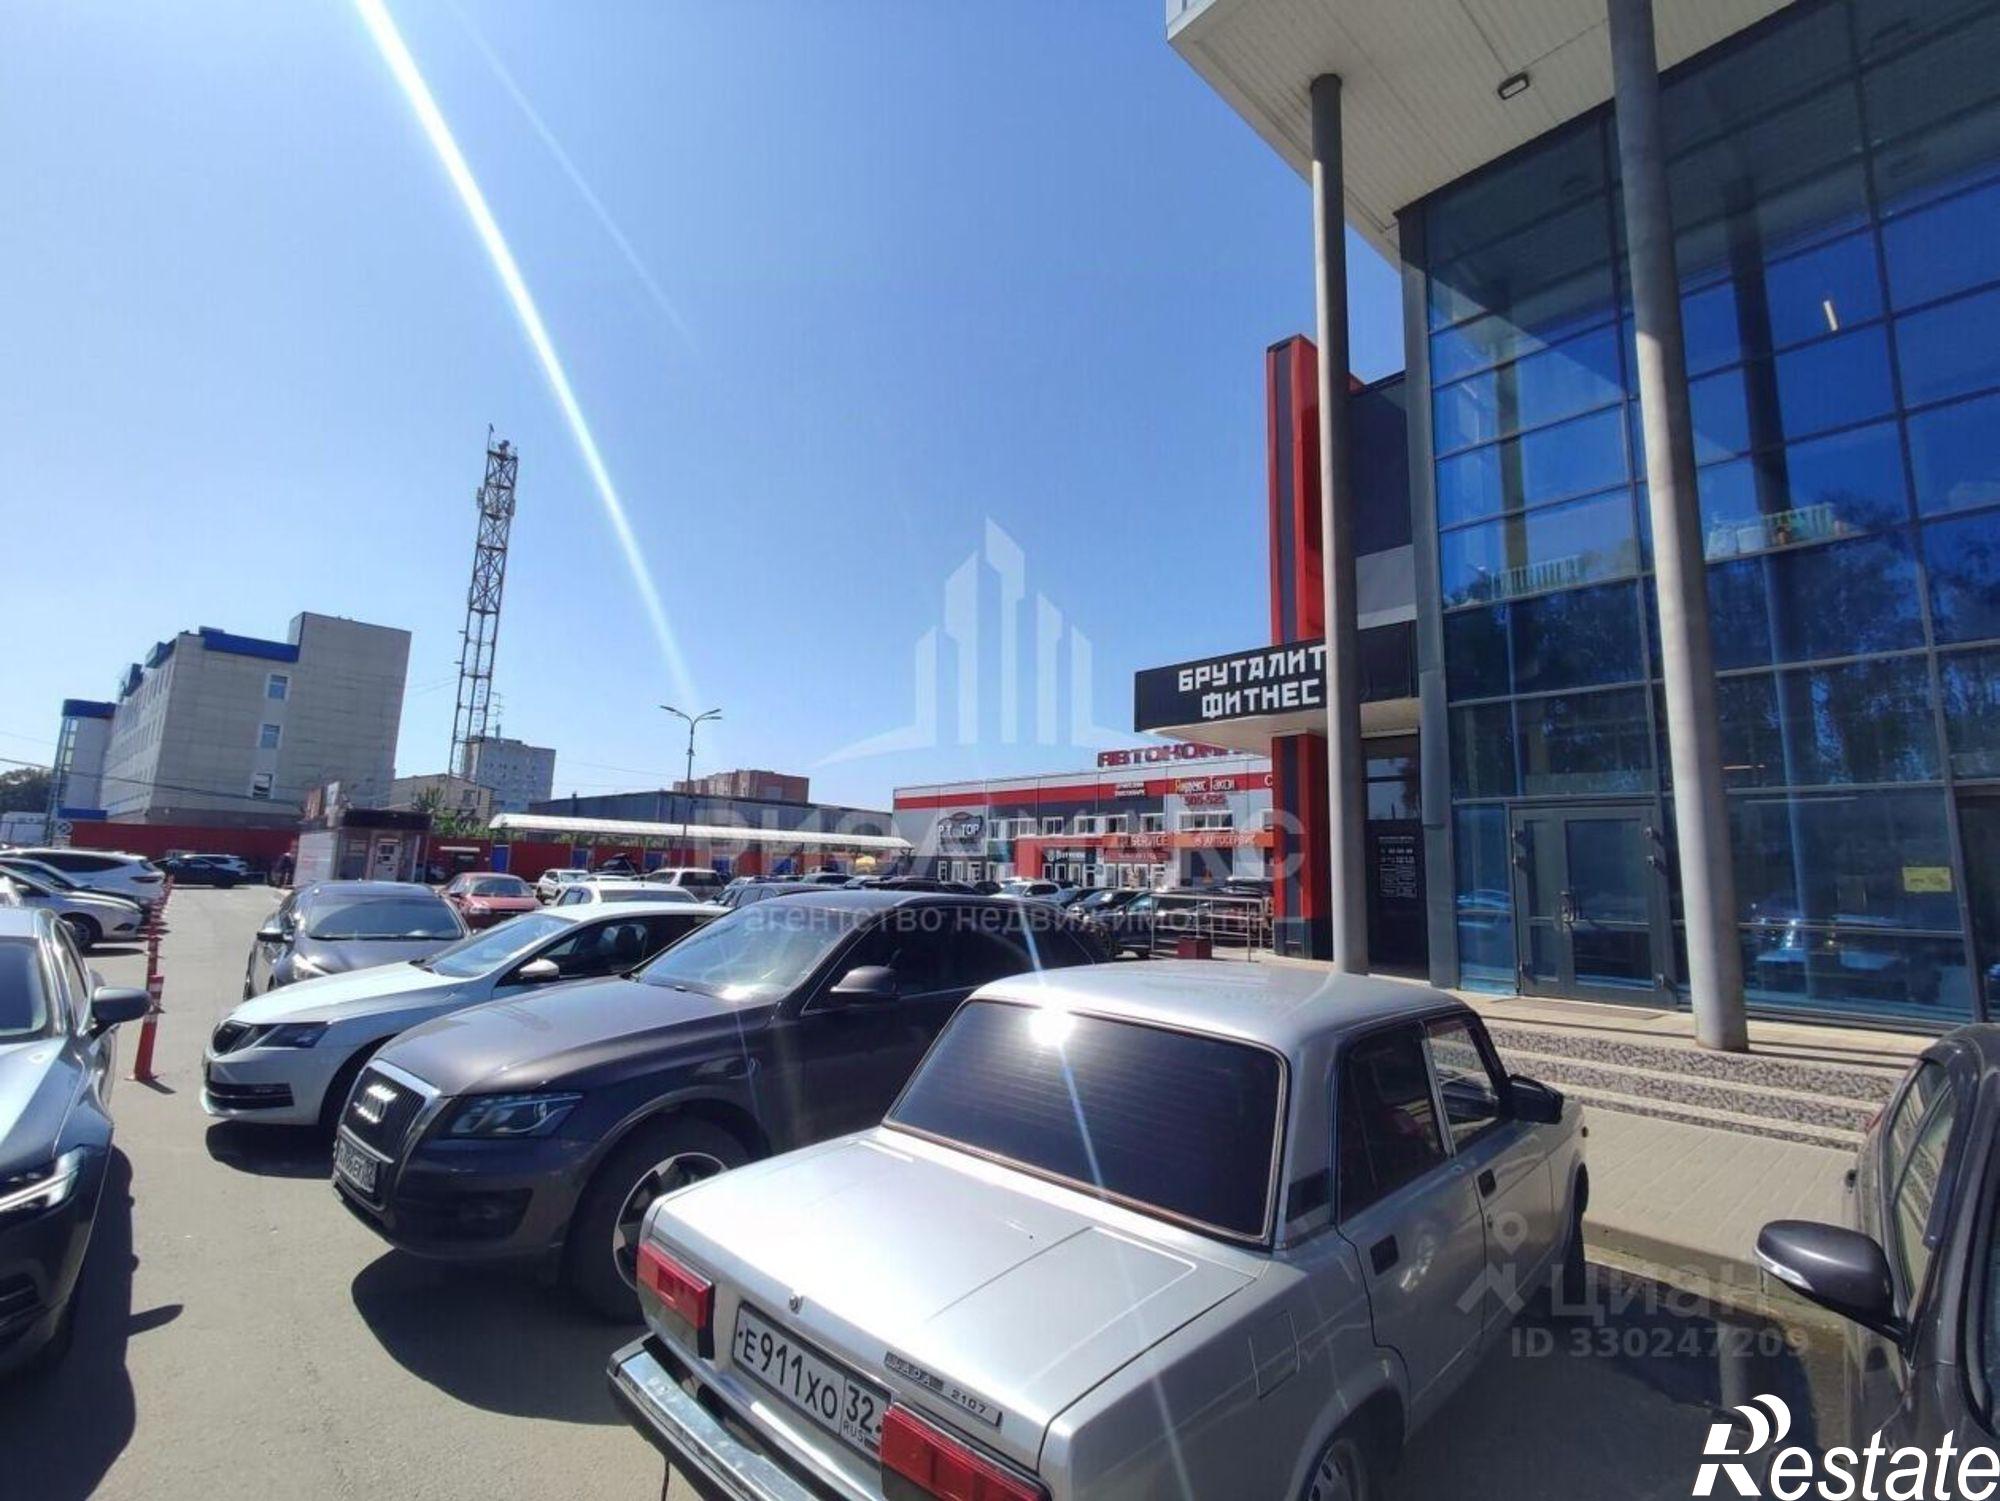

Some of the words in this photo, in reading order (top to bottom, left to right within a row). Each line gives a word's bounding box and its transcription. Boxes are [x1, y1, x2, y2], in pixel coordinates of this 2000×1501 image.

[1201, 678, 1320, 719] ФИТНЕС
[846, 1384, 875, 1434] 32
[951, 1389, 987, 1415] 2107
